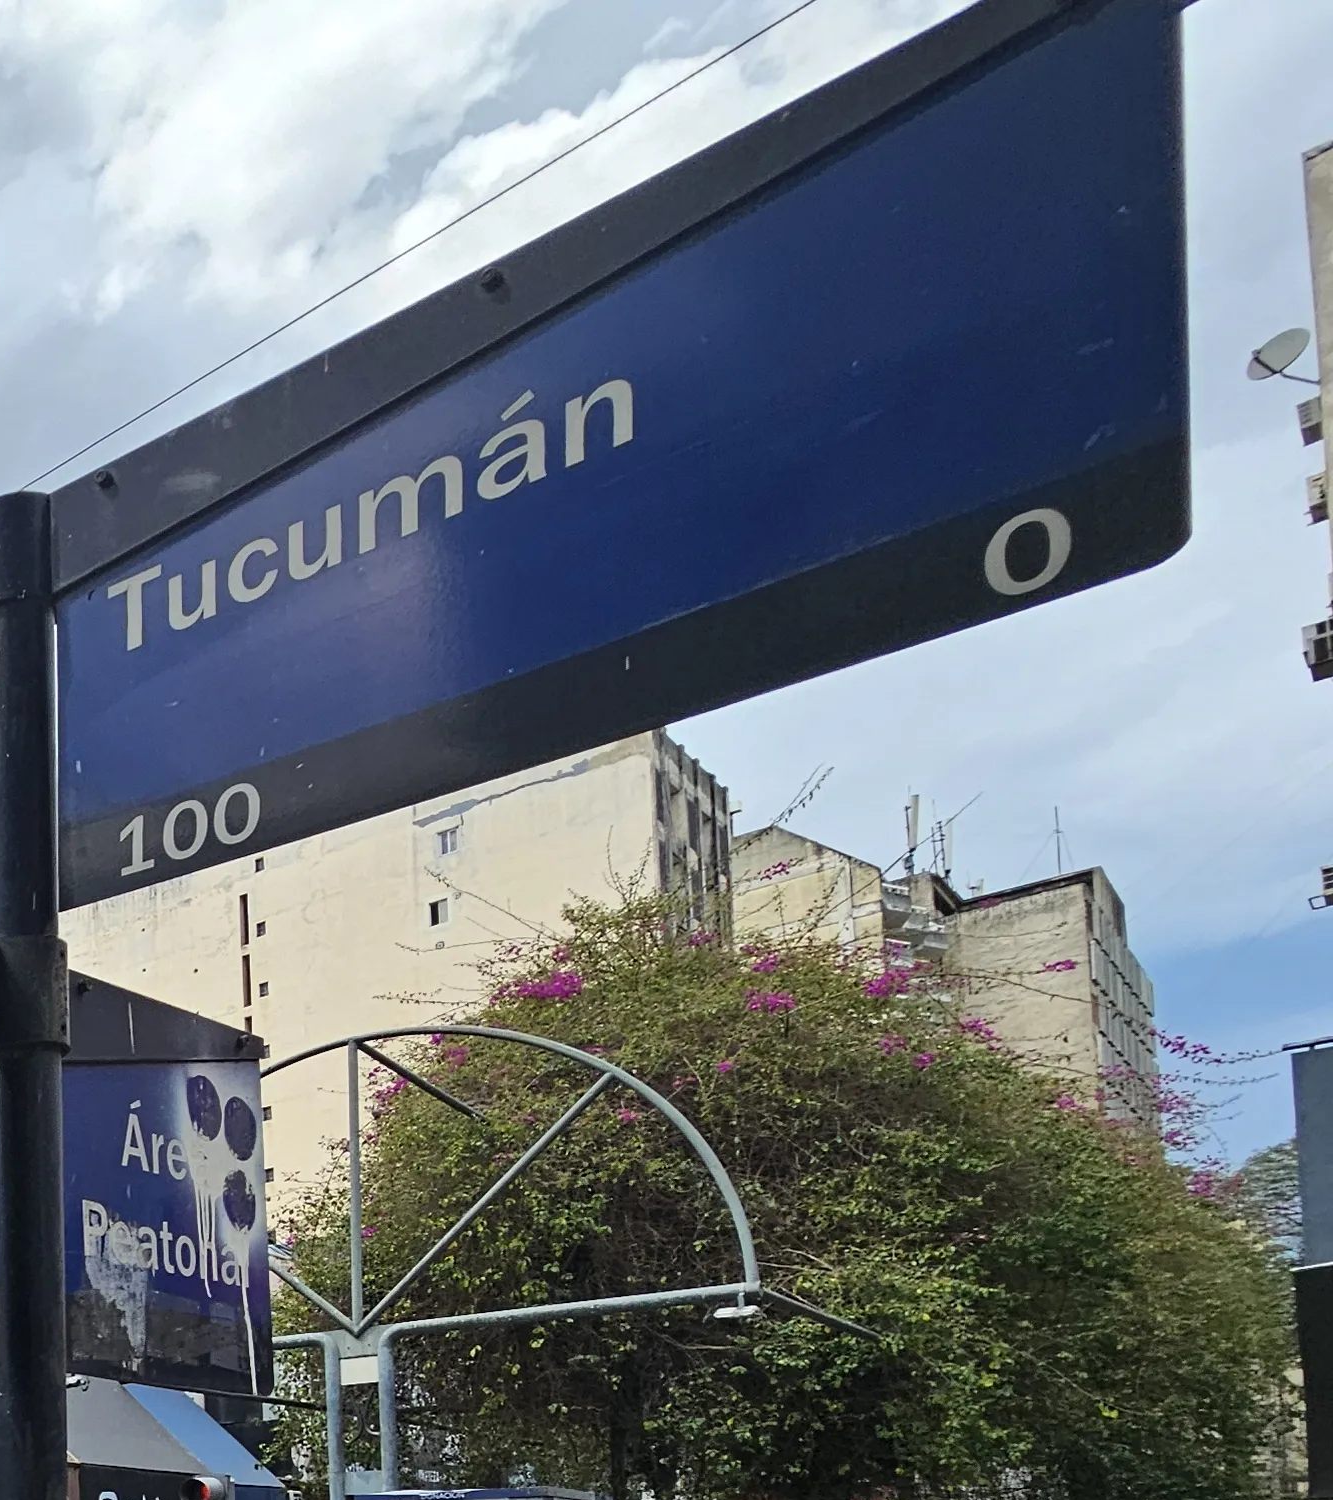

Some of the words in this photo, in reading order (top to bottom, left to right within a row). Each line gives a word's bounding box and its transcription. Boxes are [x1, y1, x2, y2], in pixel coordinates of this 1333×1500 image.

[108, 377, 637, 652] Tucumán
[983, 507, 1072, 596] O
[119, 782, 261, 877] 100
[121, 1100, 213, 1190] Áre
